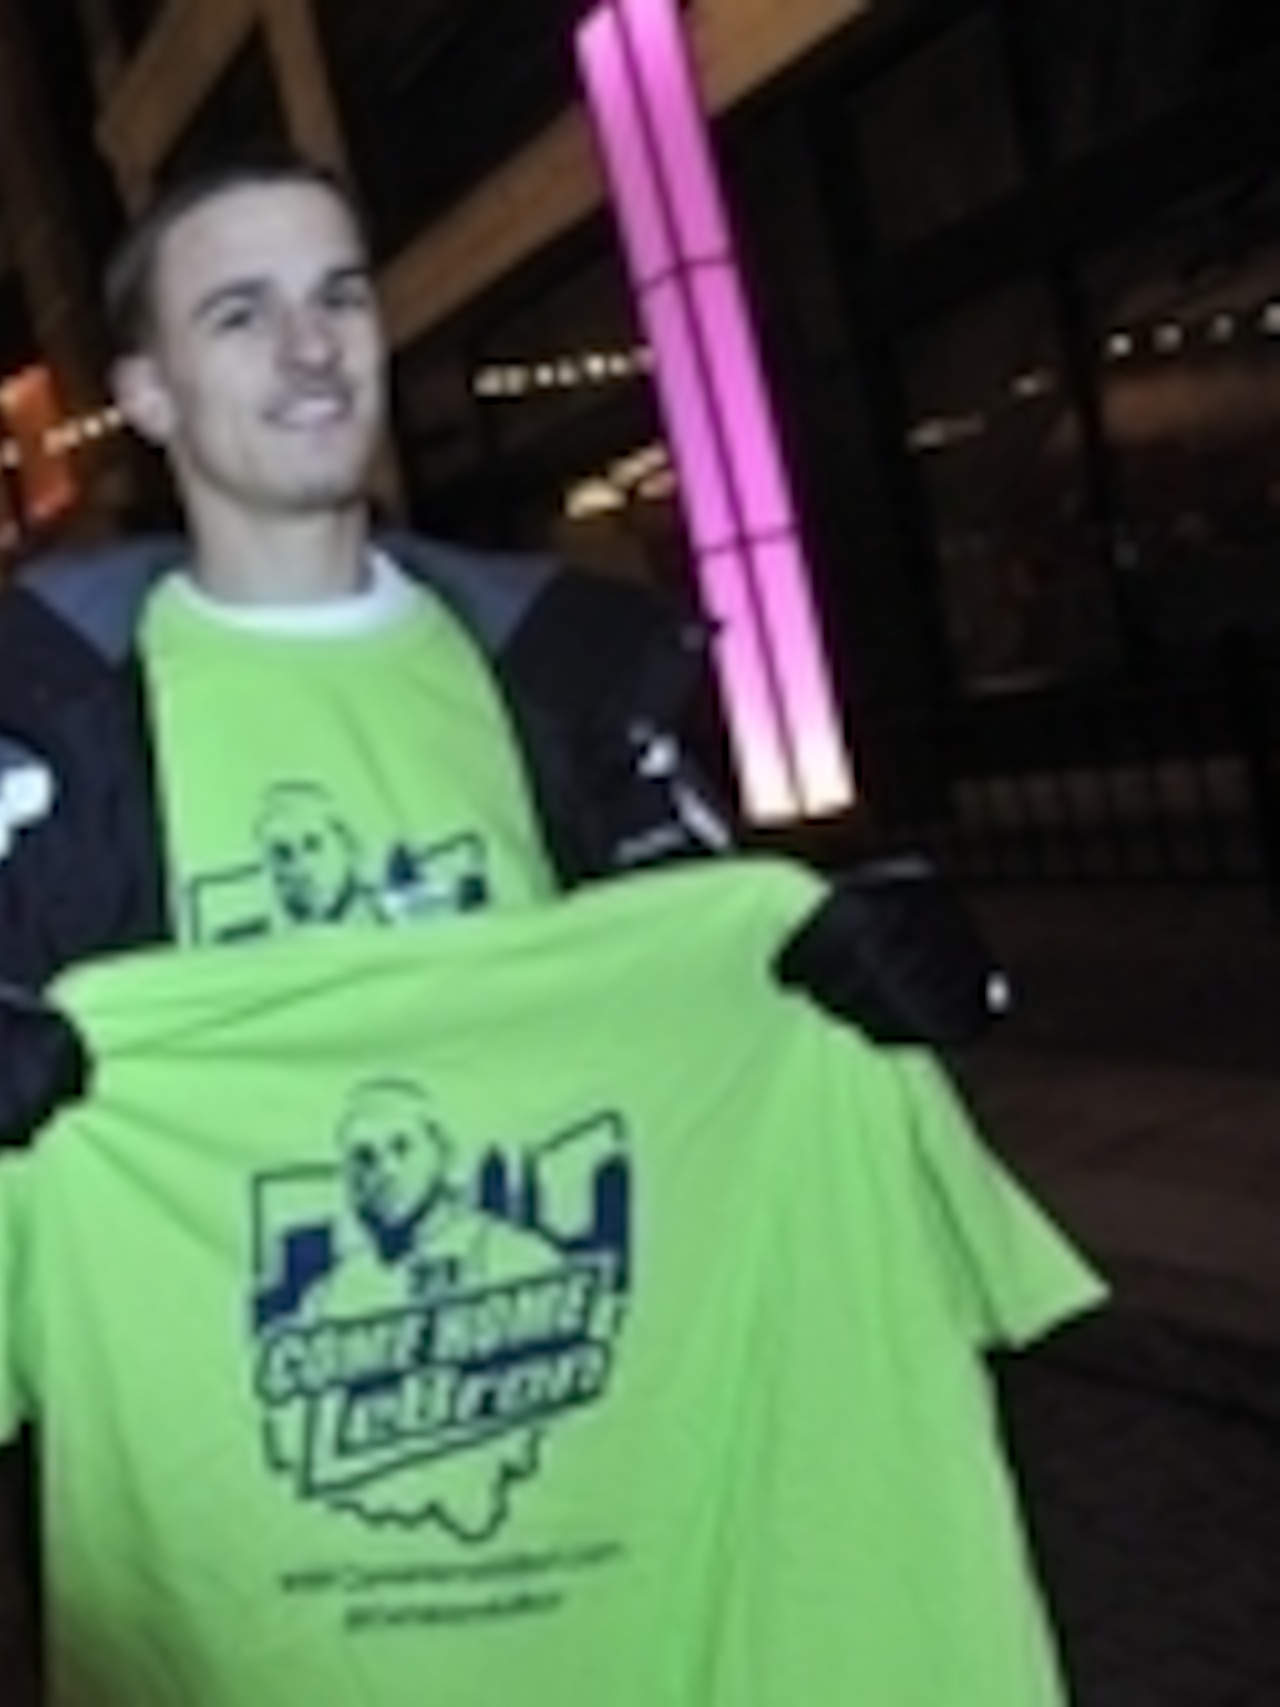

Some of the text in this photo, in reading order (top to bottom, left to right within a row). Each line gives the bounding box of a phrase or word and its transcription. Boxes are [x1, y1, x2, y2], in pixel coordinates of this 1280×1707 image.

[265, 1310, 428, 1398] COME
[434, 1268, 594, 1366] HOME
[308, 1342, 609, 1492] LeBron
